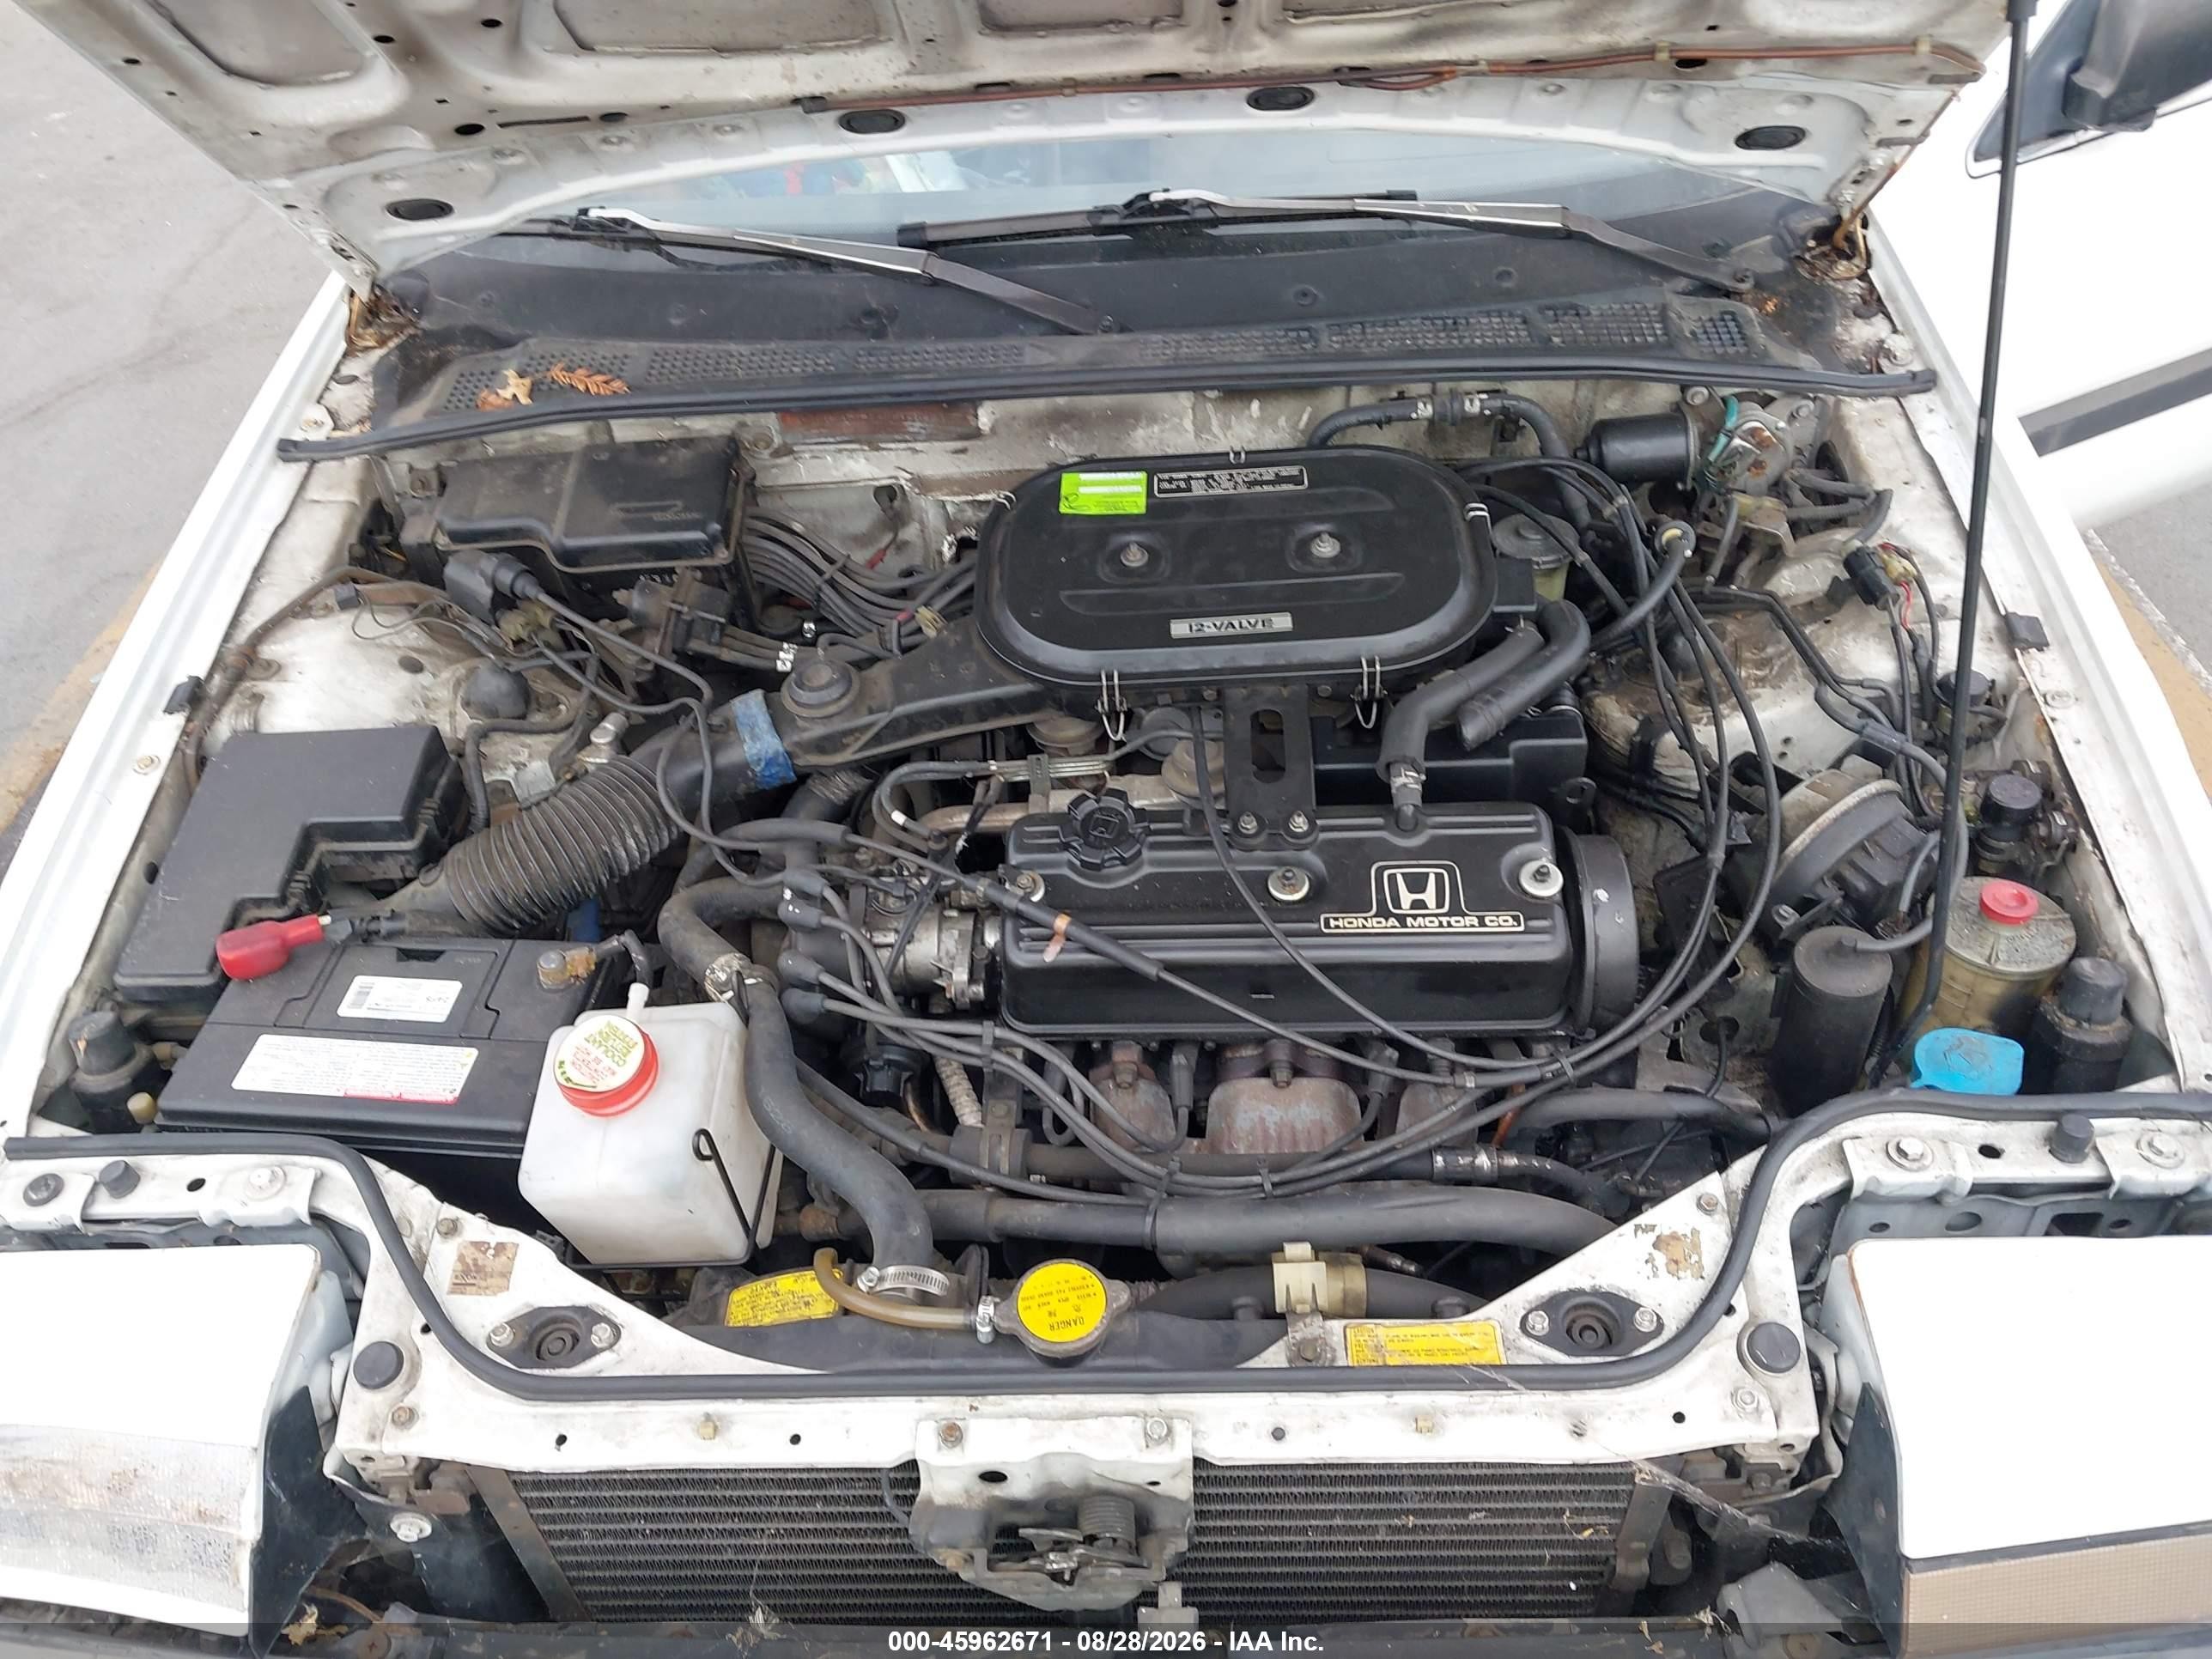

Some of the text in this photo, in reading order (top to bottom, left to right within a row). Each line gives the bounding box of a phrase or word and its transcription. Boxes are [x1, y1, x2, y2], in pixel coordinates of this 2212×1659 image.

[1188, 618, 1274, 634] 12-VALVE
[1328, 915, 1518, 928] HONDA MOTOR CO.
[583, 1033, 627, 1068] COOLANT
[1049, 1316, 1085, 1332] DANGER
